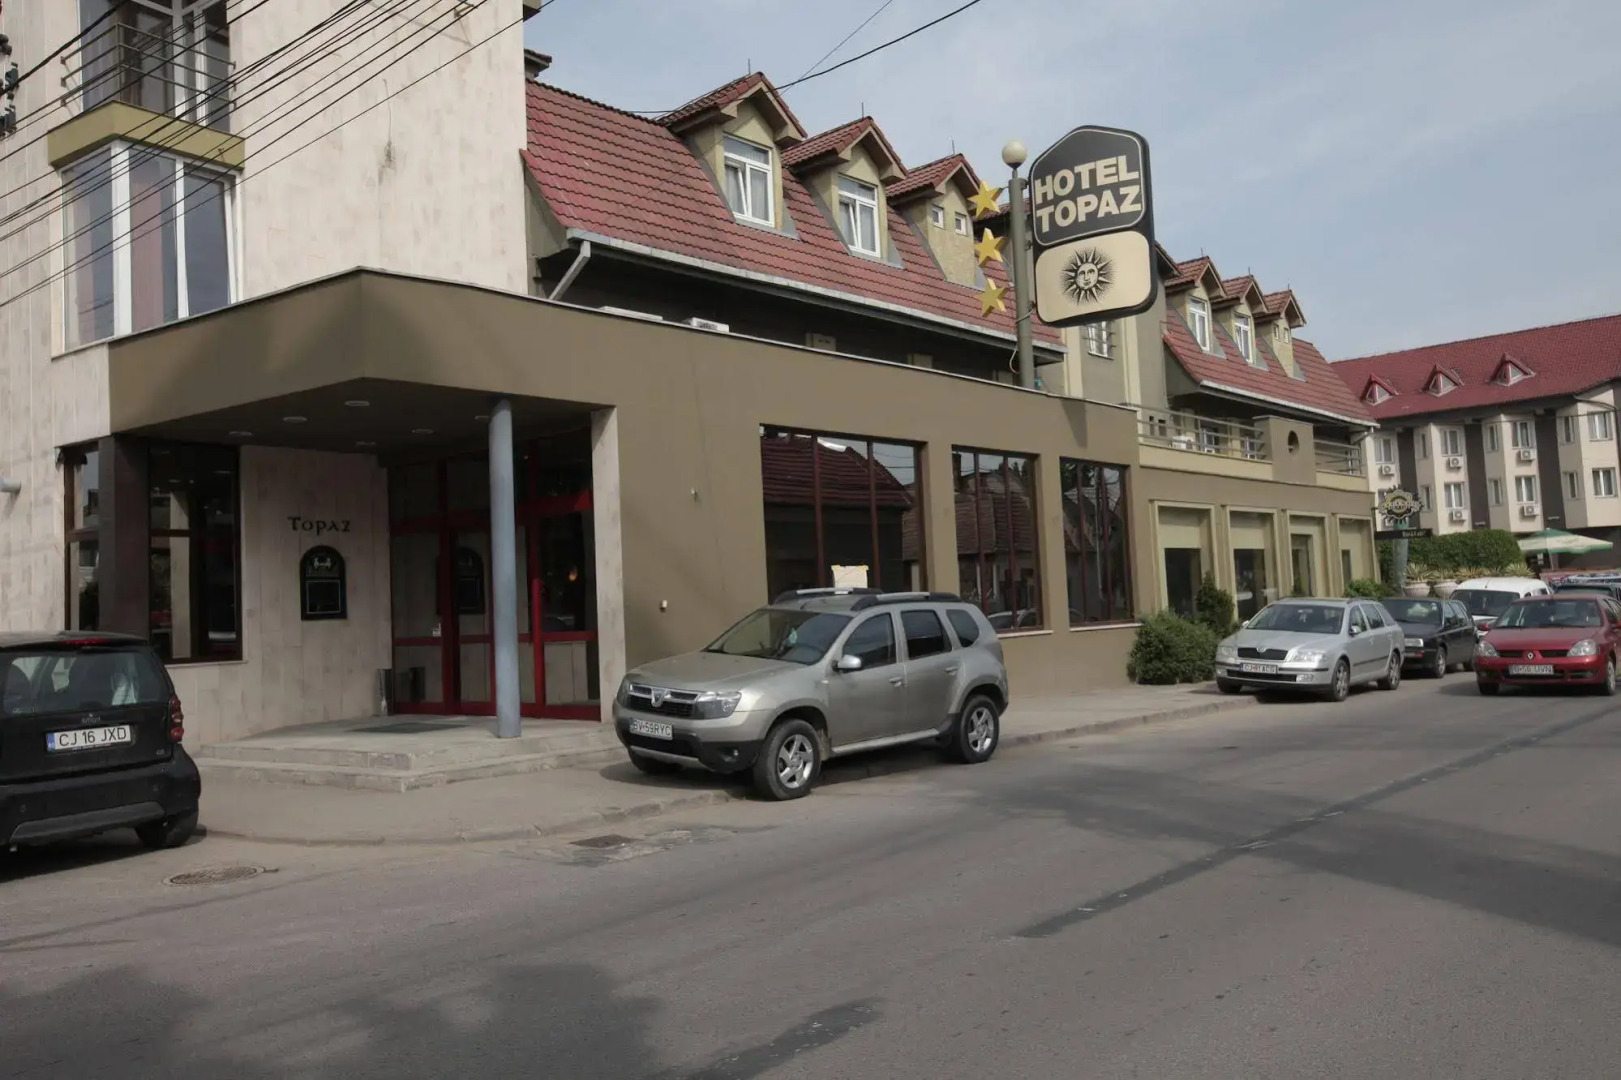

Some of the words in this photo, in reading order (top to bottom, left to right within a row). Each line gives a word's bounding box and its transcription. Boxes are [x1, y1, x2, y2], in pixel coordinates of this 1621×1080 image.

[1034, 154, 1139, 205] HOTEL
[1036, 184, 1142, 234] TOPAZ
[59, 733, 78, 747] CJ
[82, 730, 96, 744] 16
[101, 727, 127, 742] JXD
